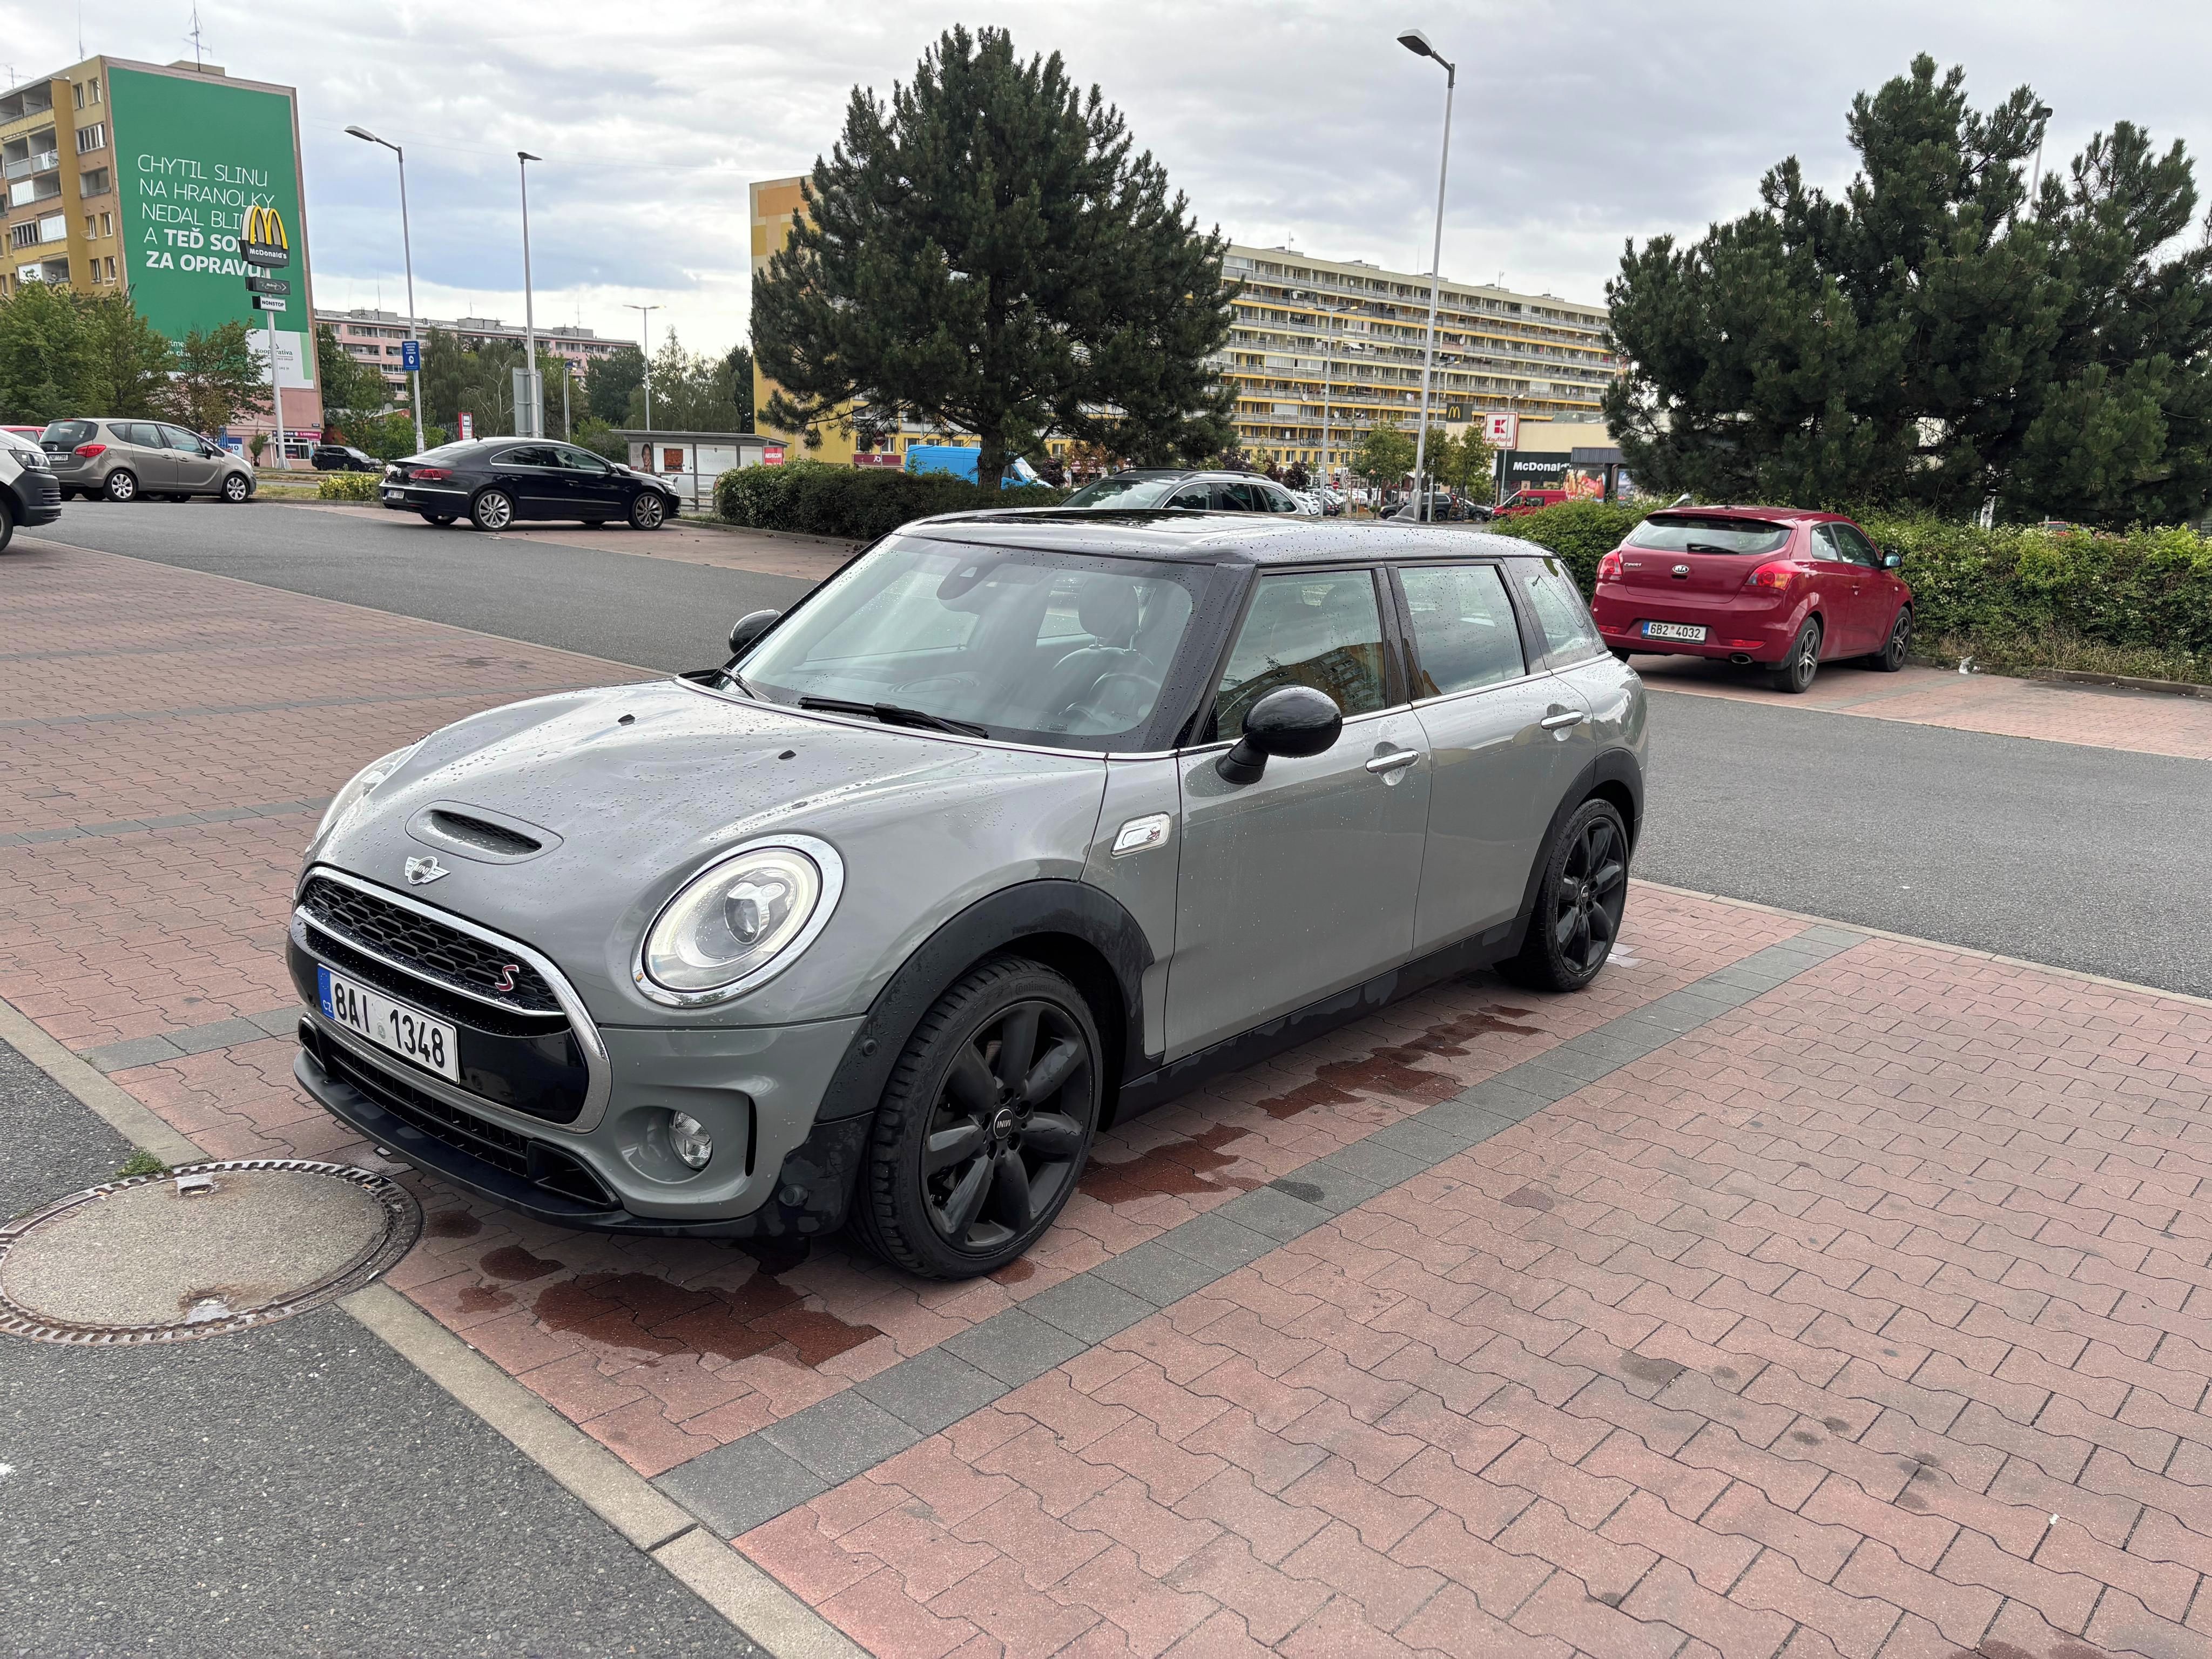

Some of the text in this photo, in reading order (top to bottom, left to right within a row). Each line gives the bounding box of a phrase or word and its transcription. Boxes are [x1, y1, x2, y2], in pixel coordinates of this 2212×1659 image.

[138, 154, 267, 187] CHYTIL SLINU
[140, 178, 274, 208] NA HRANOLKY
[142, 203, 242, 230] NEDAL BLI
[144, 227, 157, 244] A
[164, 227, 204, 248] TEĎ
[146, 250, 174, 269] ZA
[249, 248, 287, 259] McDonald's
[1650, 624, 1668, 635] 6B2
[1676, 626, 1701, 638] 4032
[415, 865, 430, 875] MINI
[494, 965, 520, 993] S
[323, 982, 445, 1069] CZ 8AI 1348
[997, 1119, 1011, 1129] MINI
